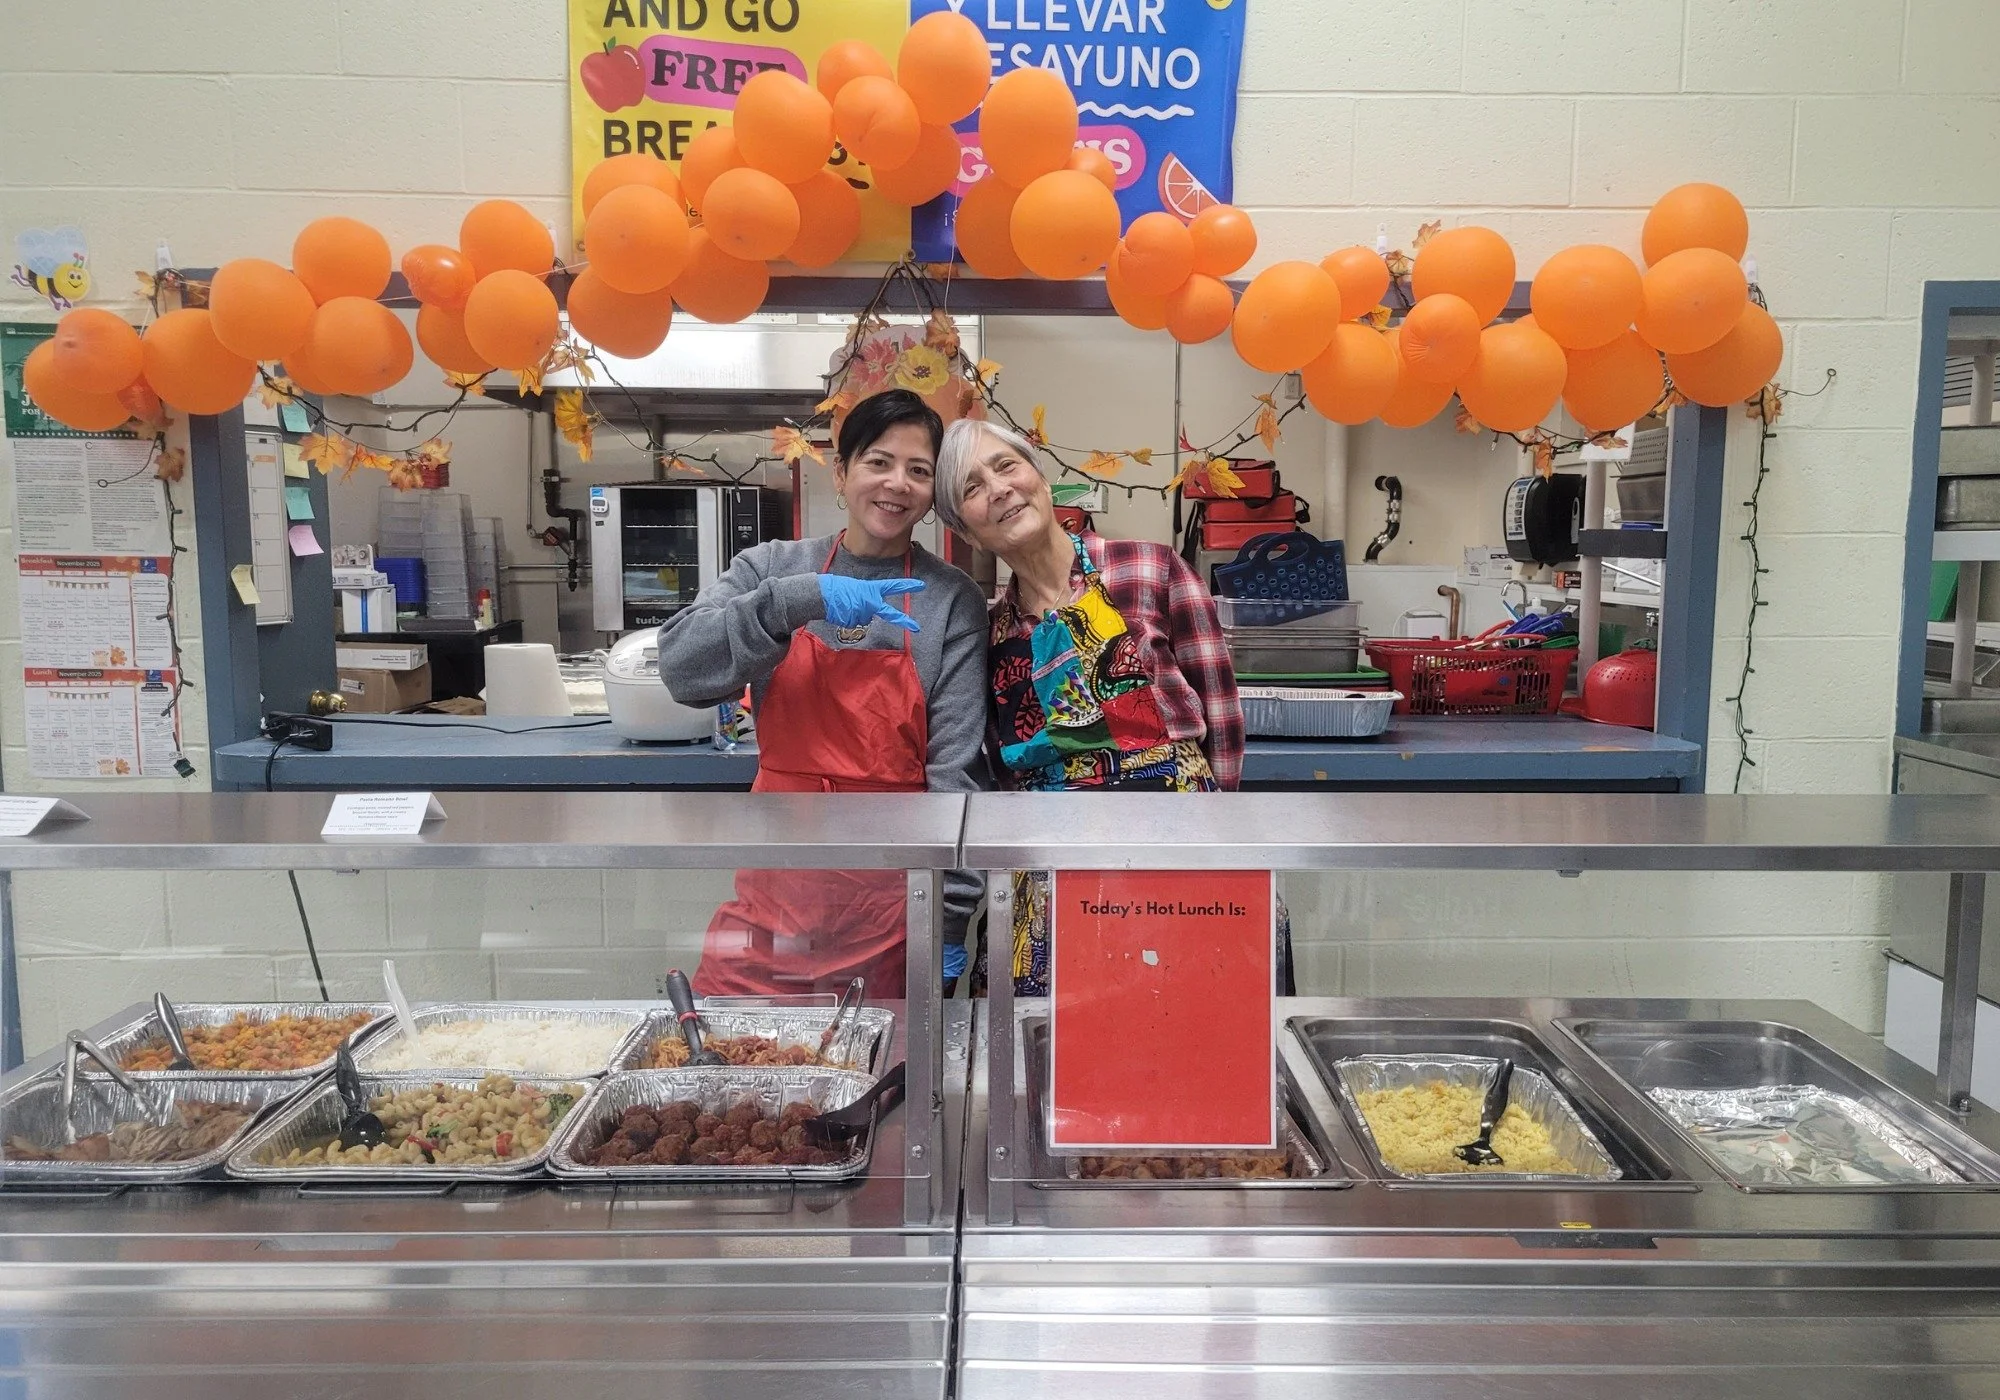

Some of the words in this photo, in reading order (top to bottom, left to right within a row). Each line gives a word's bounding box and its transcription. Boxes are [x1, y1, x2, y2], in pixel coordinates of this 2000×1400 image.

[603, 0, 708, 31] AND
[724, 0, 800, 33] GO
[987, 0, 1167, 34] LLEVAR
[651, 48, 787, 95] FRE
[1080, 900, 1142, 918] Today's
[1147, 902, 1174, 915] Hot
[1179, 901, 1224, 916] Lunch
[1229, 902, 1246, 916] Is:
